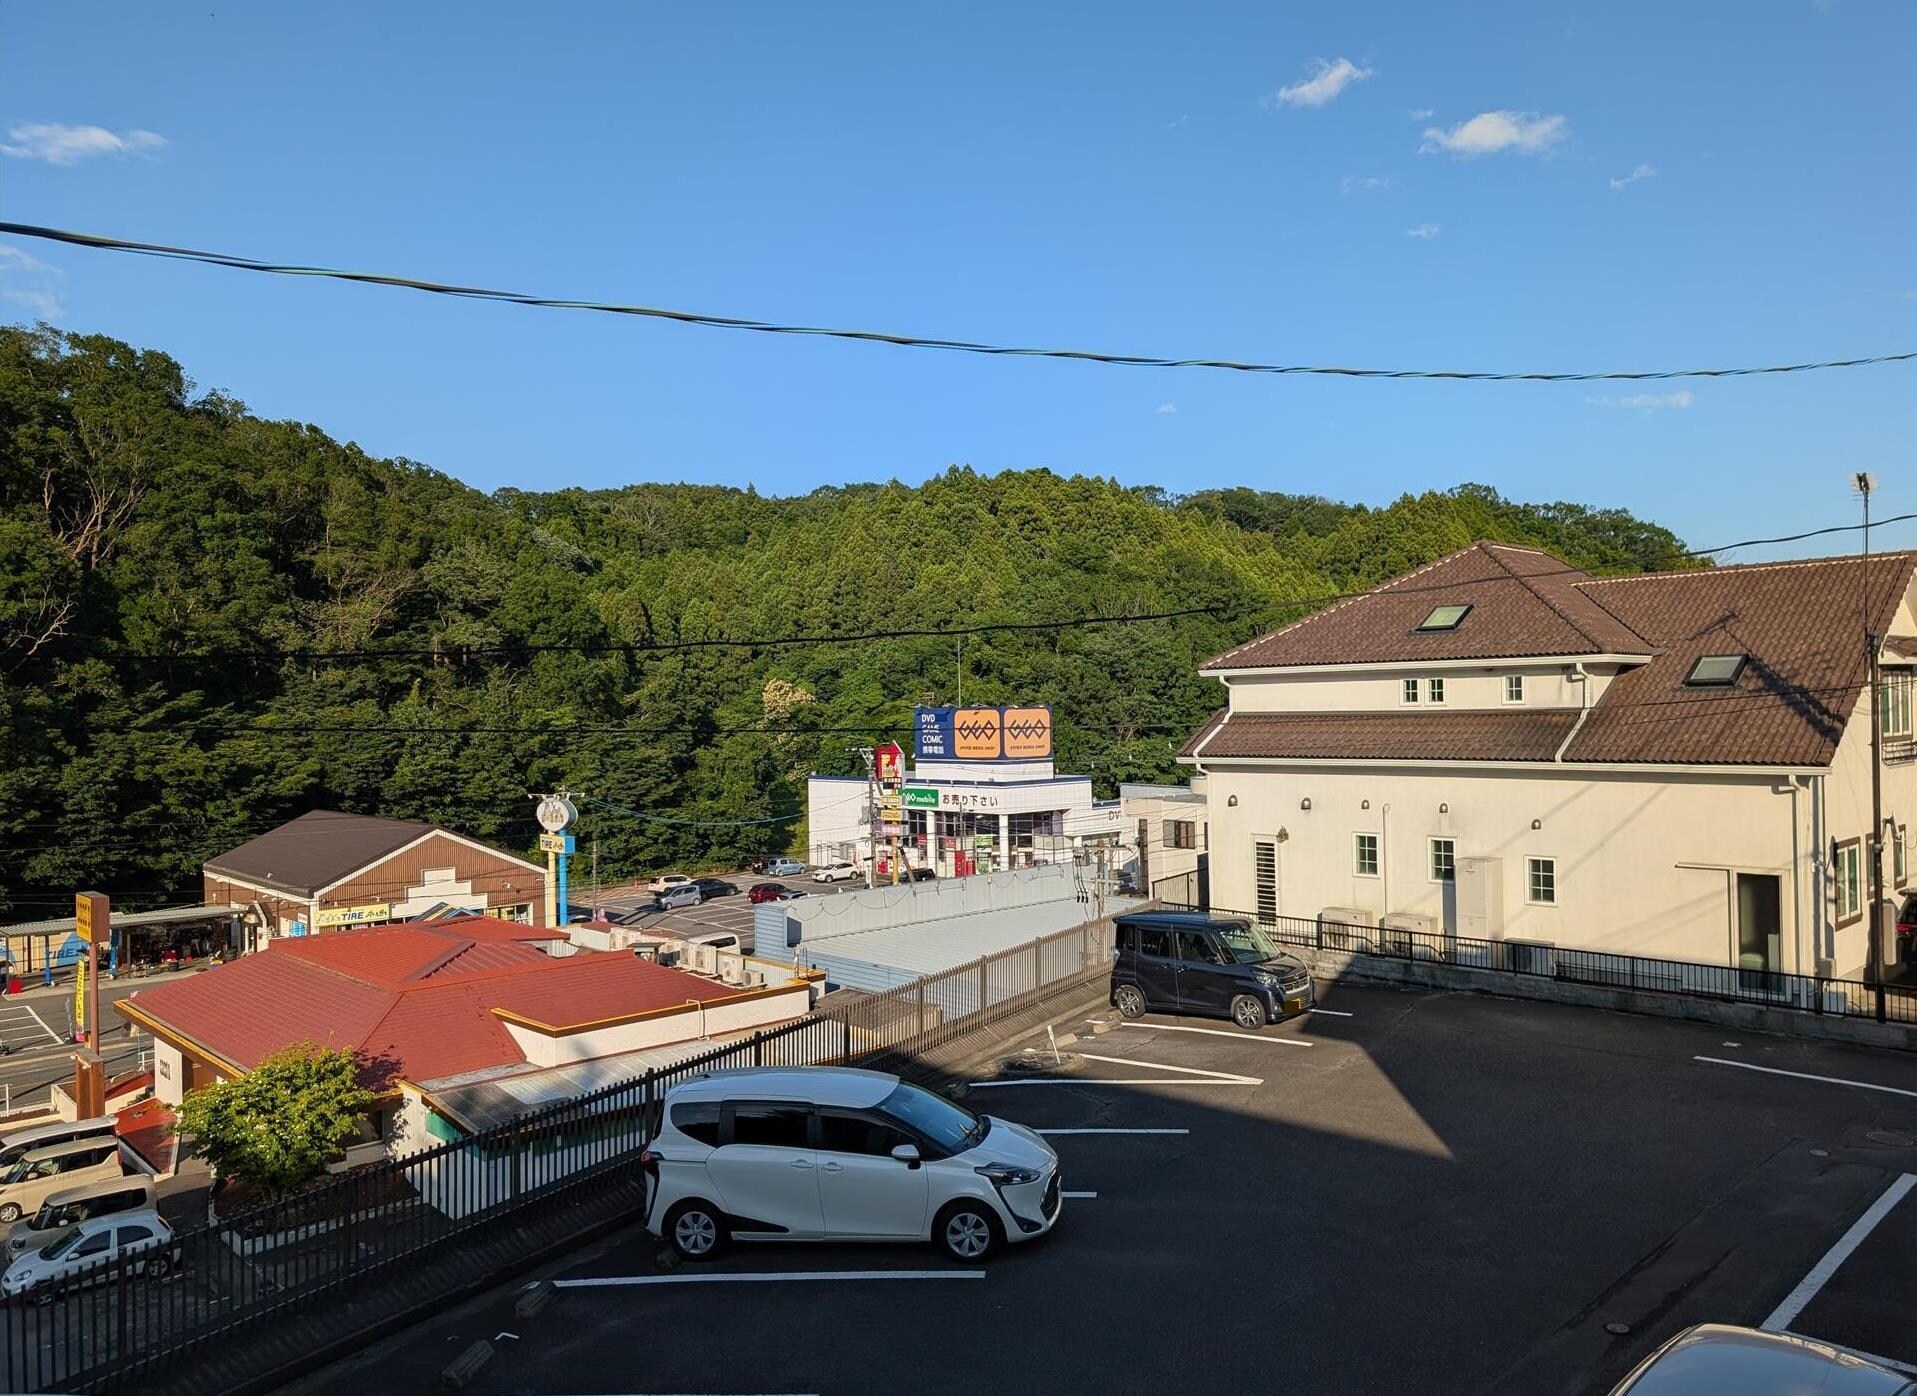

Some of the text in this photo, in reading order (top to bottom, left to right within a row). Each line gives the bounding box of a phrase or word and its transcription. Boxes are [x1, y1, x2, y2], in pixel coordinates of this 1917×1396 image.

[921, 714, 936, 722] DVD
[922, 735, 943, 743] COMIC
[916, 794, 935, 804] mobile
[942, 794, 998, 806] お売り下さい
[341, 911, 364, 921] TIRE
